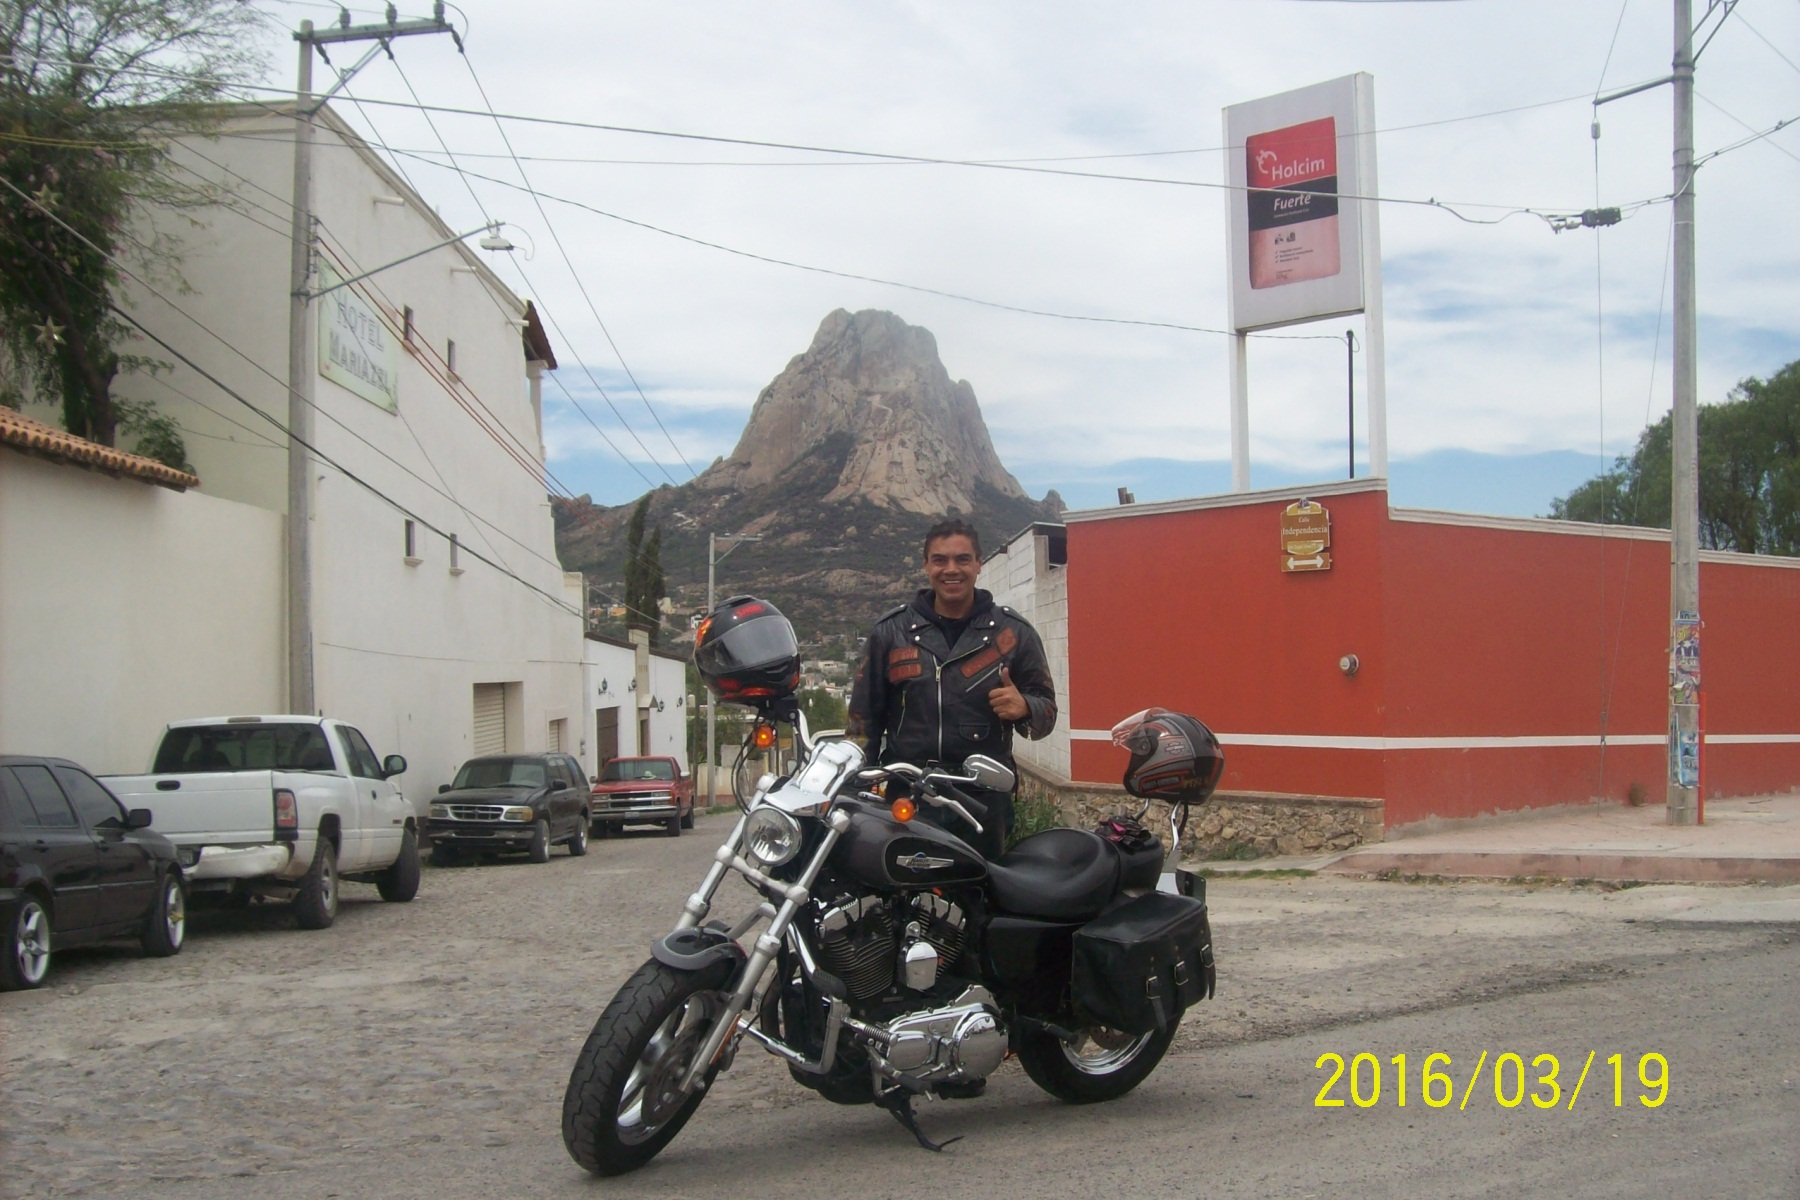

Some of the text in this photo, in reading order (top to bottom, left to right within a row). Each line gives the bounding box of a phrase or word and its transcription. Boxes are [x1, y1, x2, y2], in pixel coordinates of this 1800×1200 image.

[1272, 157, 1325, 181] Holcim
[1273, 193, 1311, 211] Fuerte
[336, 286, 384, 352] HOTEL
[1282, 525, 1328, 537] Independencia
